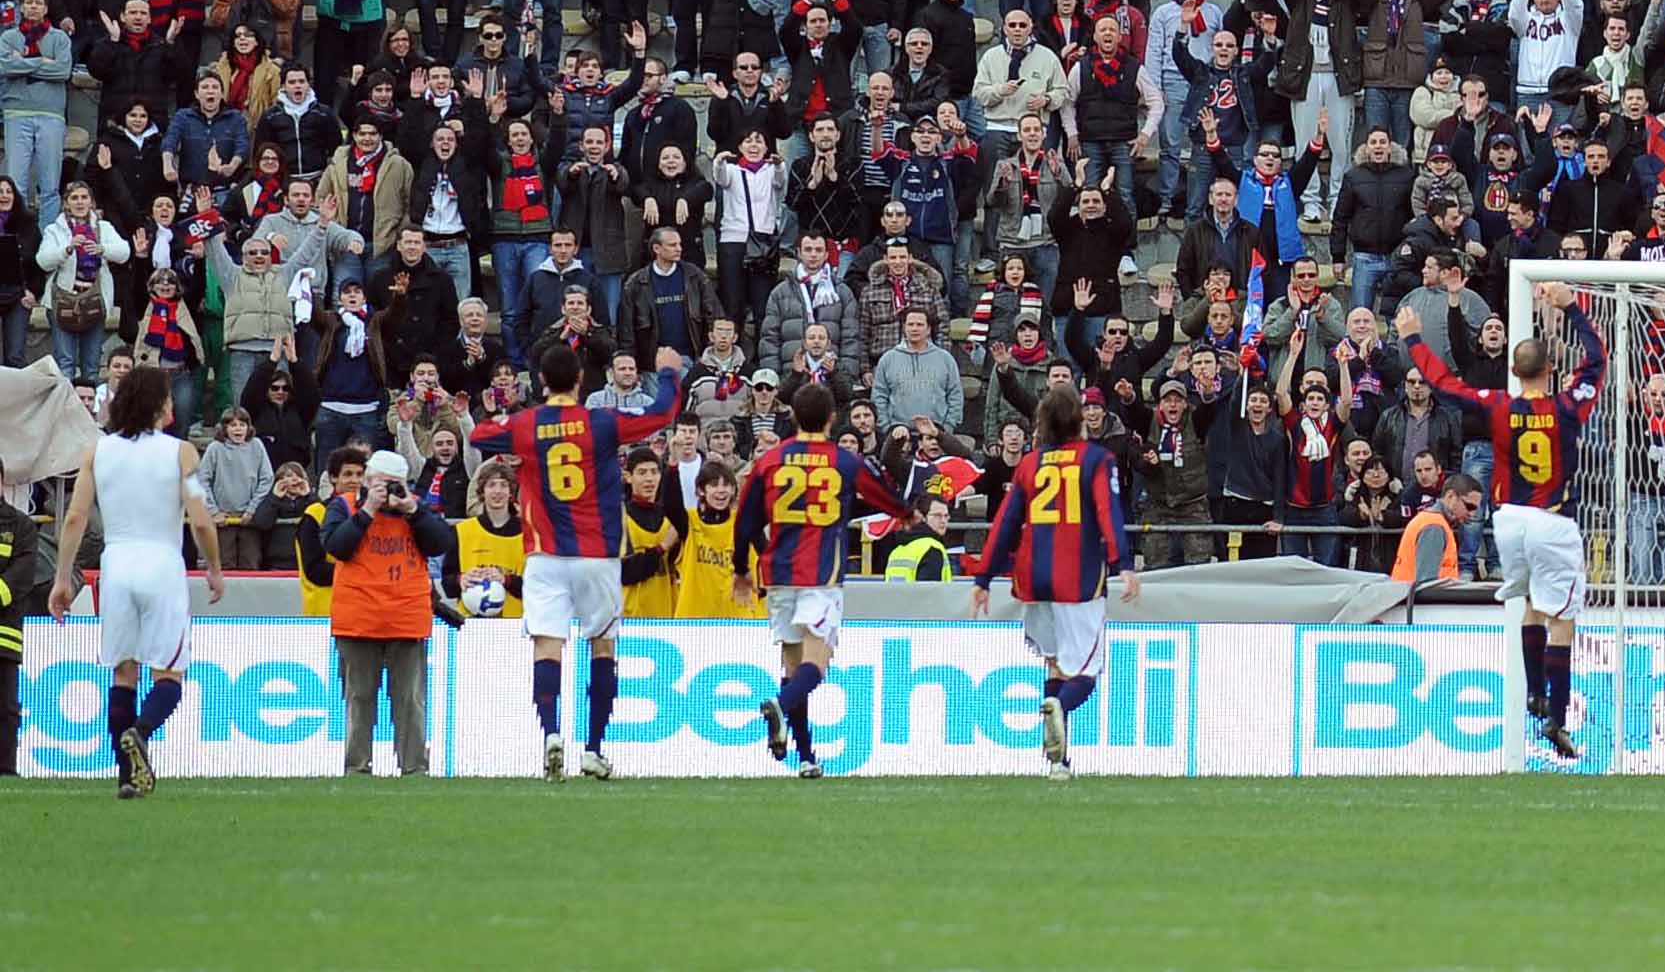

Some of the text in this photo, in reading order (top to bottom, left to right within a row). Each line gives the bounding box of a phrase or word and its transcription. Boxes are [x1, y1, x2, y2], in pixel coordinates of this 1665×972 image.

[1510, 414, 1555, 429] DI VAIO
[547, 442, 586, 503] 6
[1518, 430, 1553, 486] 9
[771, 465, 843, 526] 23
[1030, 464, 1082, 524] 21
